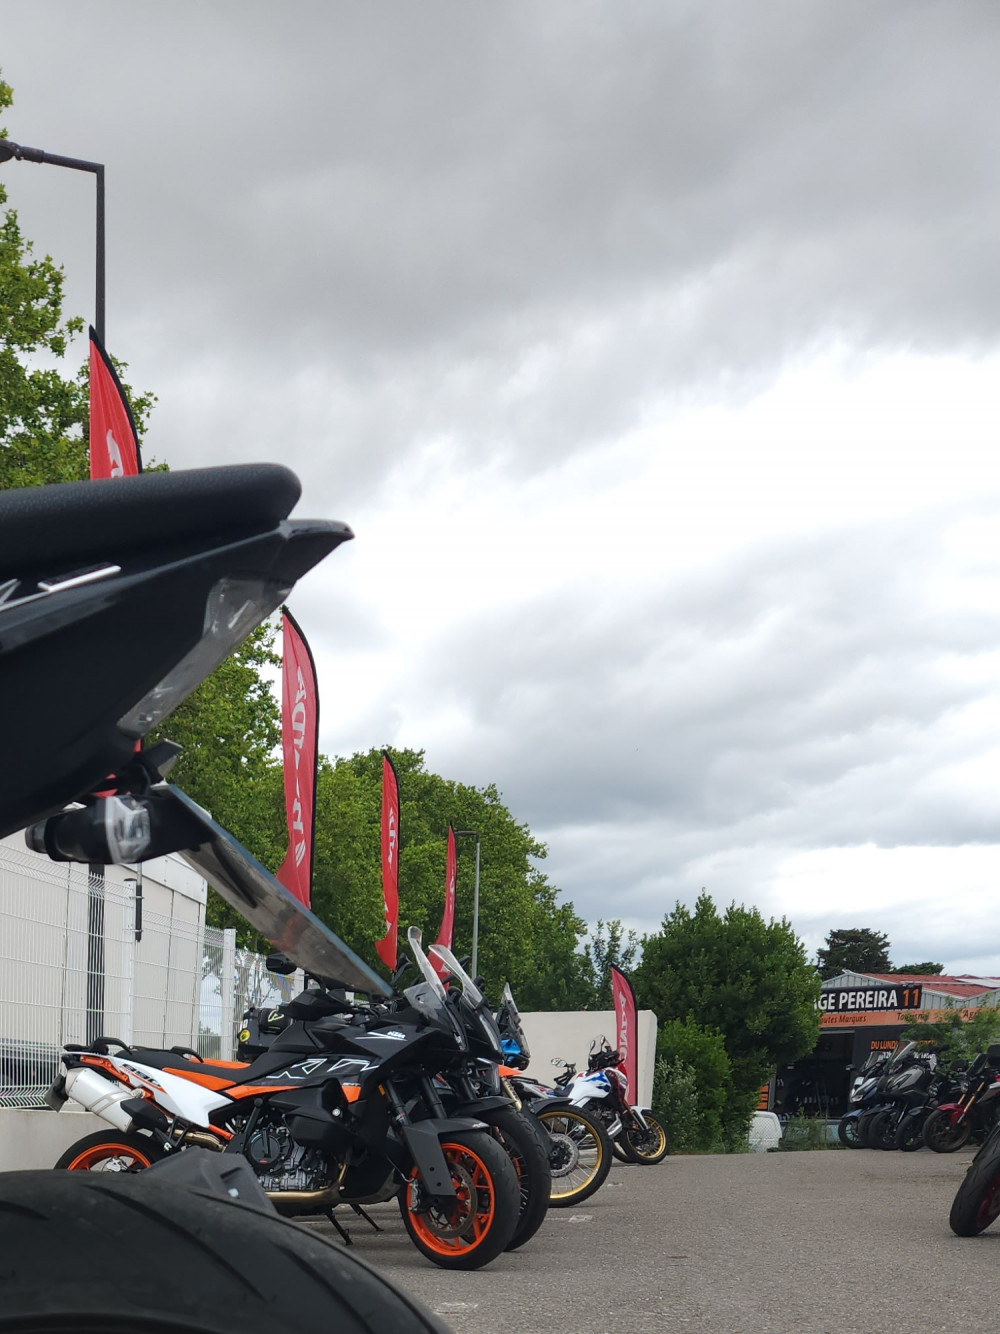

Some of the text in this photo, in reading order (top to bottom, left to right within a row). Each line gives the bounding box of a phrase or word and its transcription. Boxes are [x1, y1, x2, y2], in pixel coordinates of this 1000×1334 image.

[838, 989, 898, 1010] PEREIRA
[903, 988, 919, 1006] 11
[839, 1014, 867, 1025] Marques
